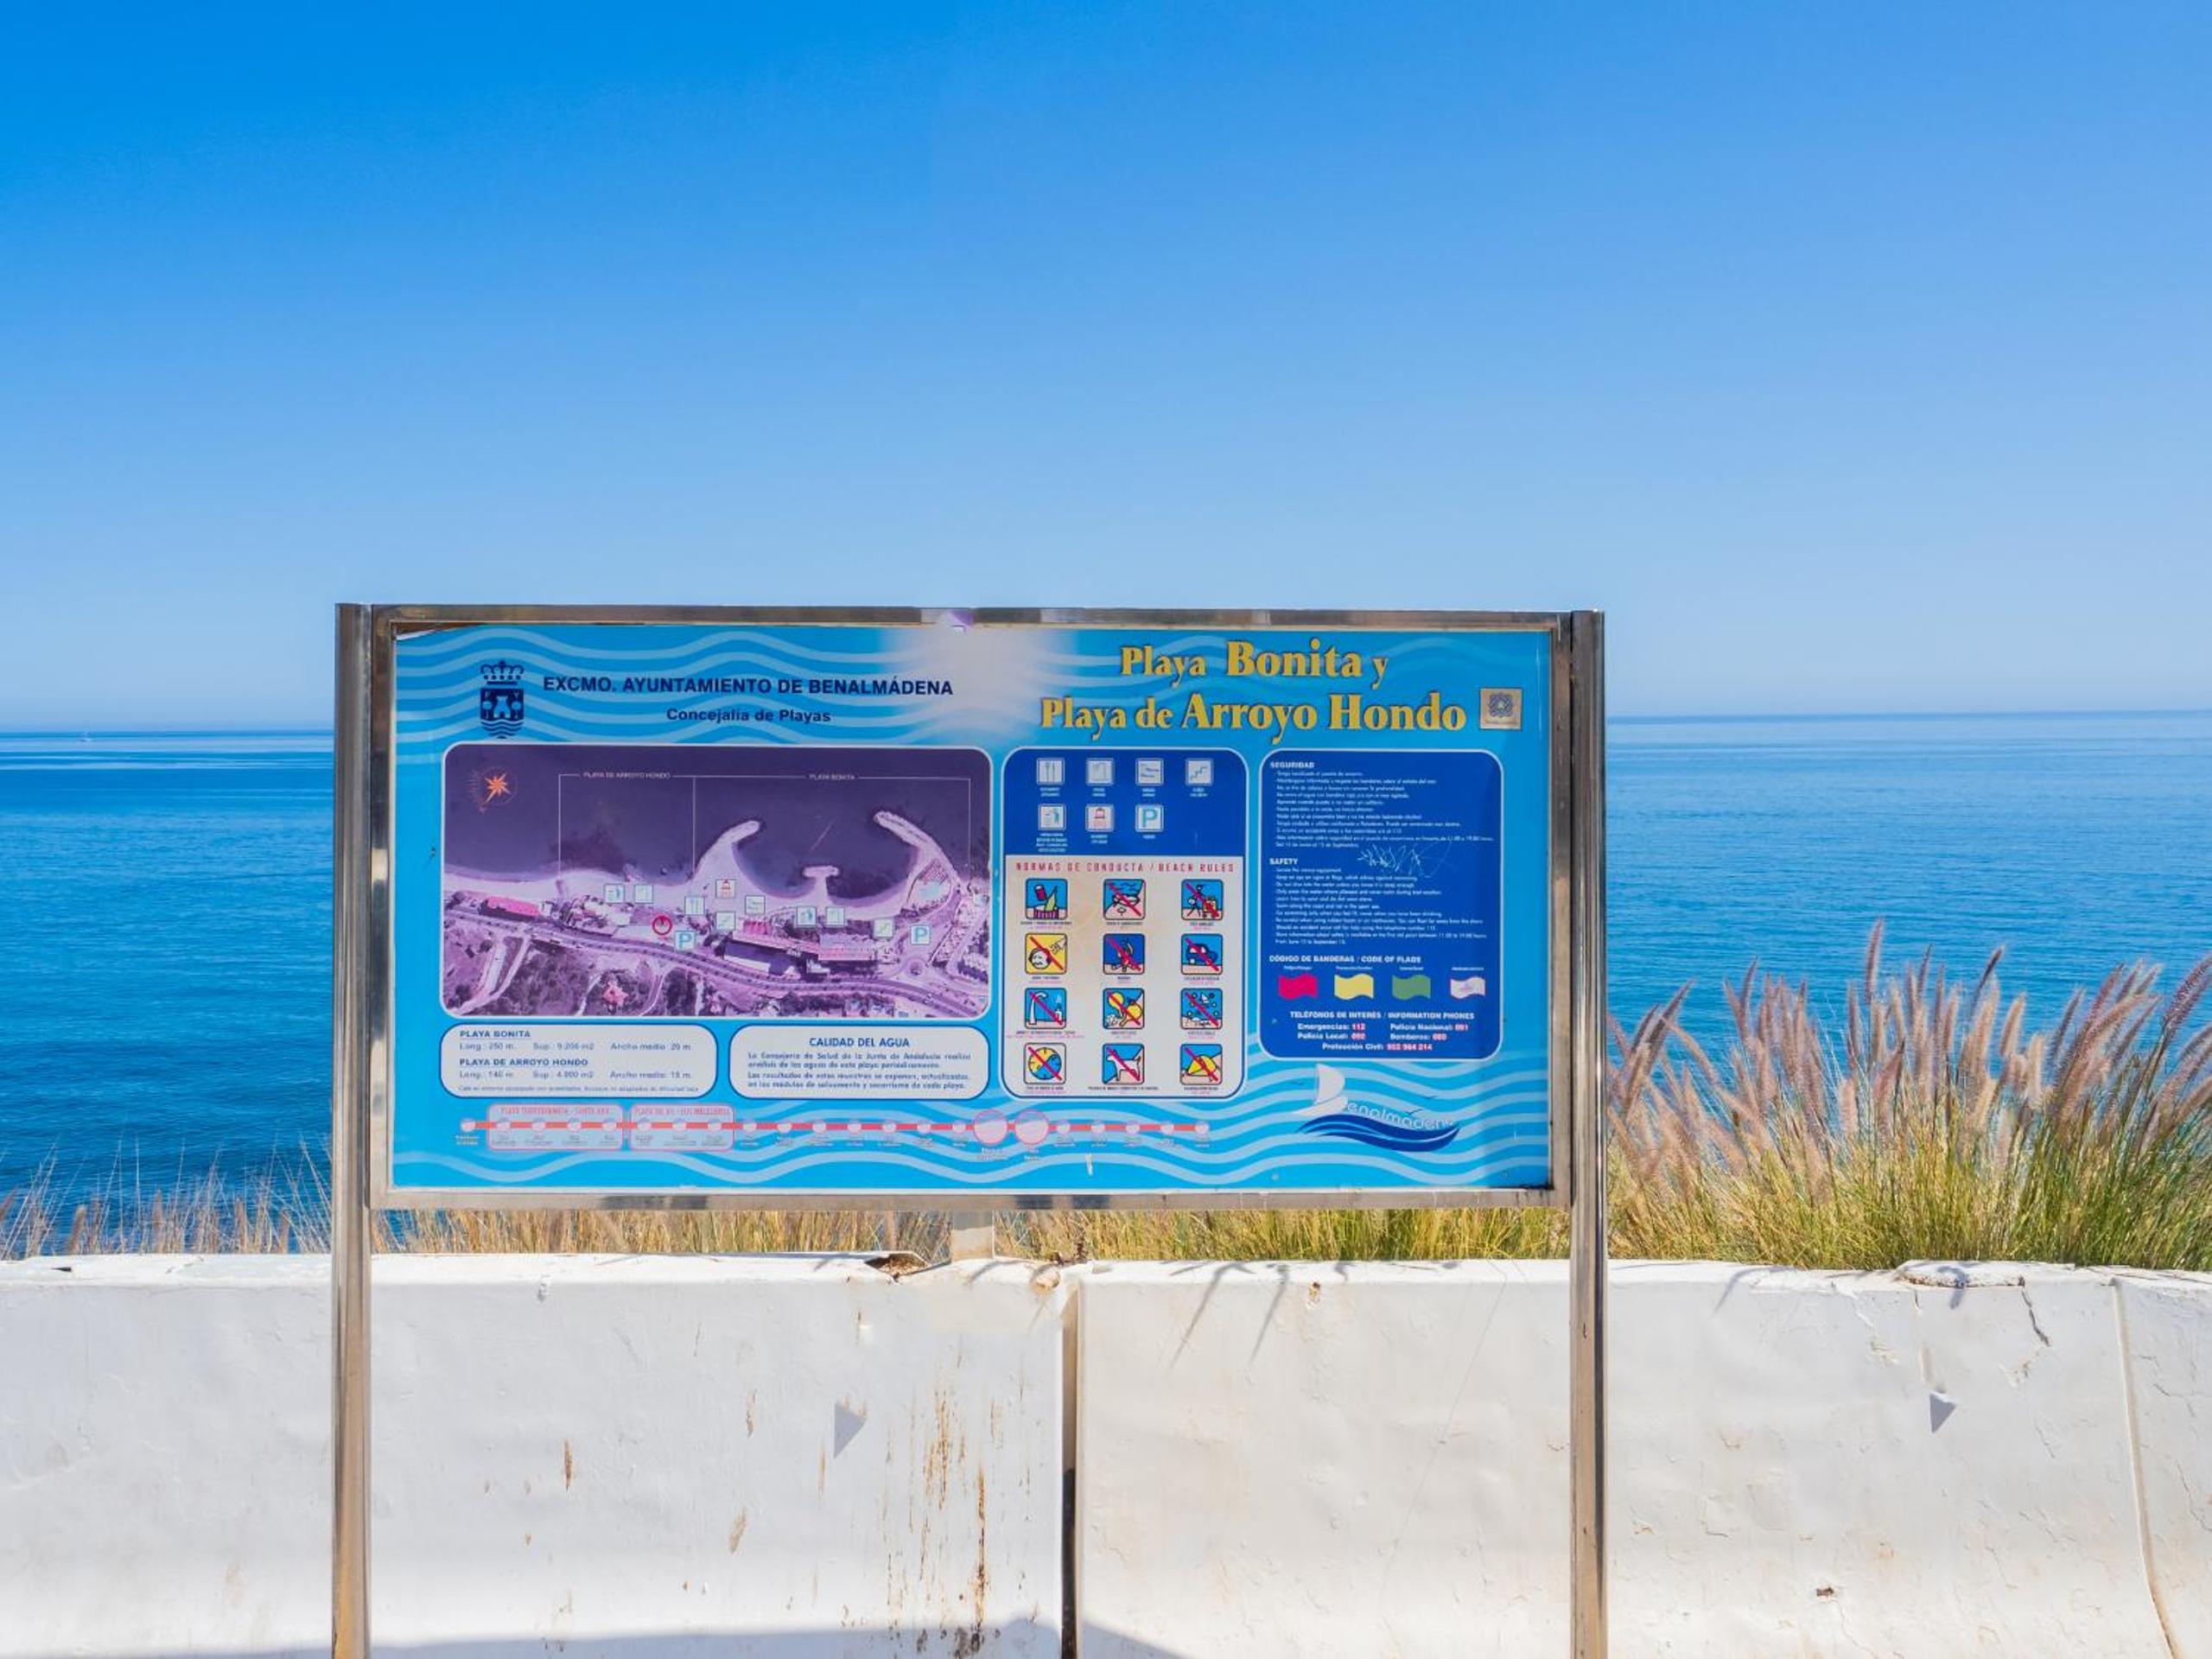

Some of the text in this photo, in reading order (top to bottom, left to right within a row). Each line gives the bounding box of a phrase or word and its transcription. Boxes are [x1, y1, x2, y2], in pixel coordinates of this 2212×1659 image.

[1120, 638, 1389, 690] Playa Bonita y
[543, 675, 954, 696] EXCMO. AYUNTAMIENTO DE BENALMÁDENA
[754, 708, 775, 721] de
[779, 709, 831, 723] Playas
[1039, 690, 1468, 745] Playa de Arroyo Hondo
[1015, 862, 1061, 872] NORMAS
[1067, 862, 1080, 872] DE
[1087, 862, 1144, 872] CONDUCTA
[1159, 862, 1193, 872] BEACH
[1199, 862, 1234, 872] RULES
[1269, 857, 1299, 866] SAFETY
[1298, 1023, 1350, 1032] Emergencias:
[809, 1038, 910, 1047] CALIDAD DEL AGUA
